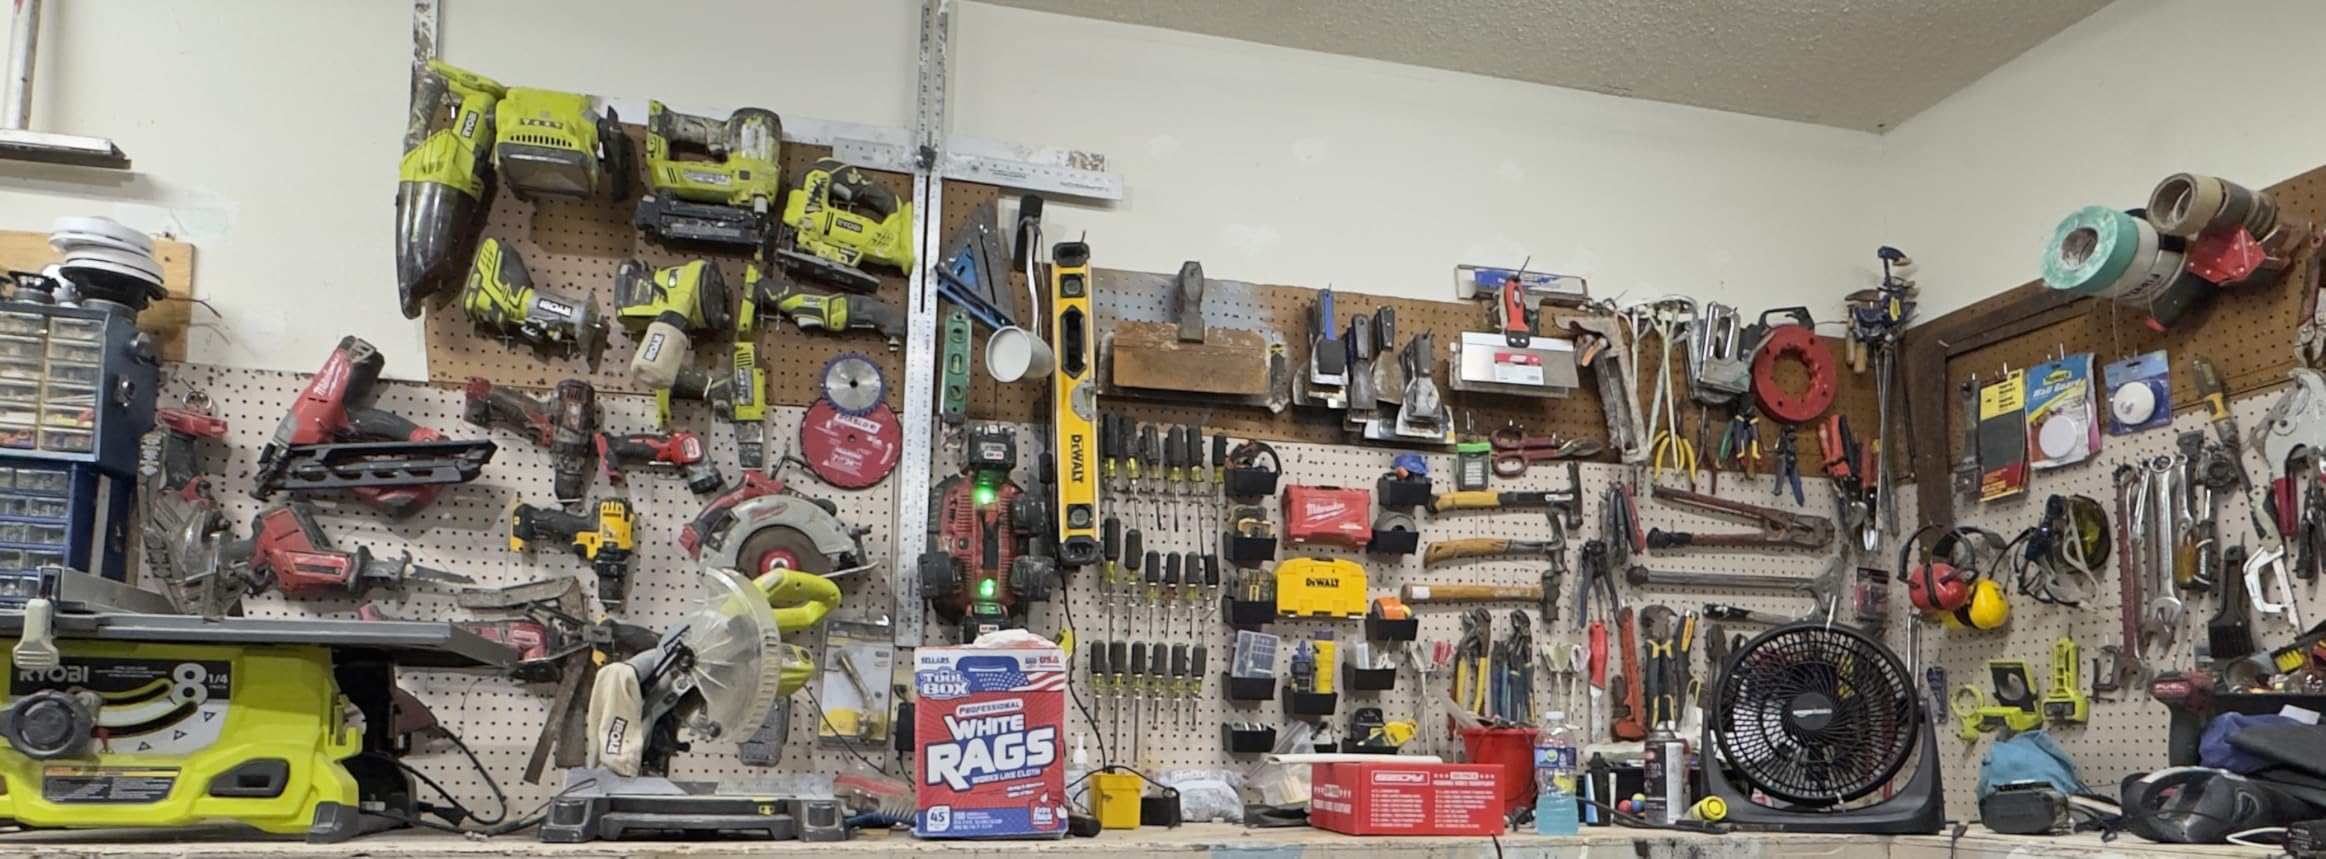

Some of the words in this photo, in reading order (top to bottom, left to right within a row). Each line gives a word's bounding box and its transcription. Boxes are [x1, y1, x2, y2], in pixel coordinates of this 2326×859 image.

[464, 112, 478, 137] RYOBI
[838, 220, 861, 232] RYOBI
[539, 300, 572, 316] RYOBI
[645, 335, 664, 361] RYOBI
[19, 665, 88, 683] RYOBI
[172, 663, 208, 706] 8
[208, 674, 228, 684] 1/4
[923, 683, 968, 694] BOX
[959, 702, 1020, 714] PROFESSIONAL
[607, 719, 626, 753] RYOBI
[944, 714, 1025, 740] WHITE
[928, 727, 1055, 790] RAGS
[1000, 771, 1016, 780] LIKE
[1017, 768, 1041, 778] CLOTH
[930, 811, 945, 822] 45
